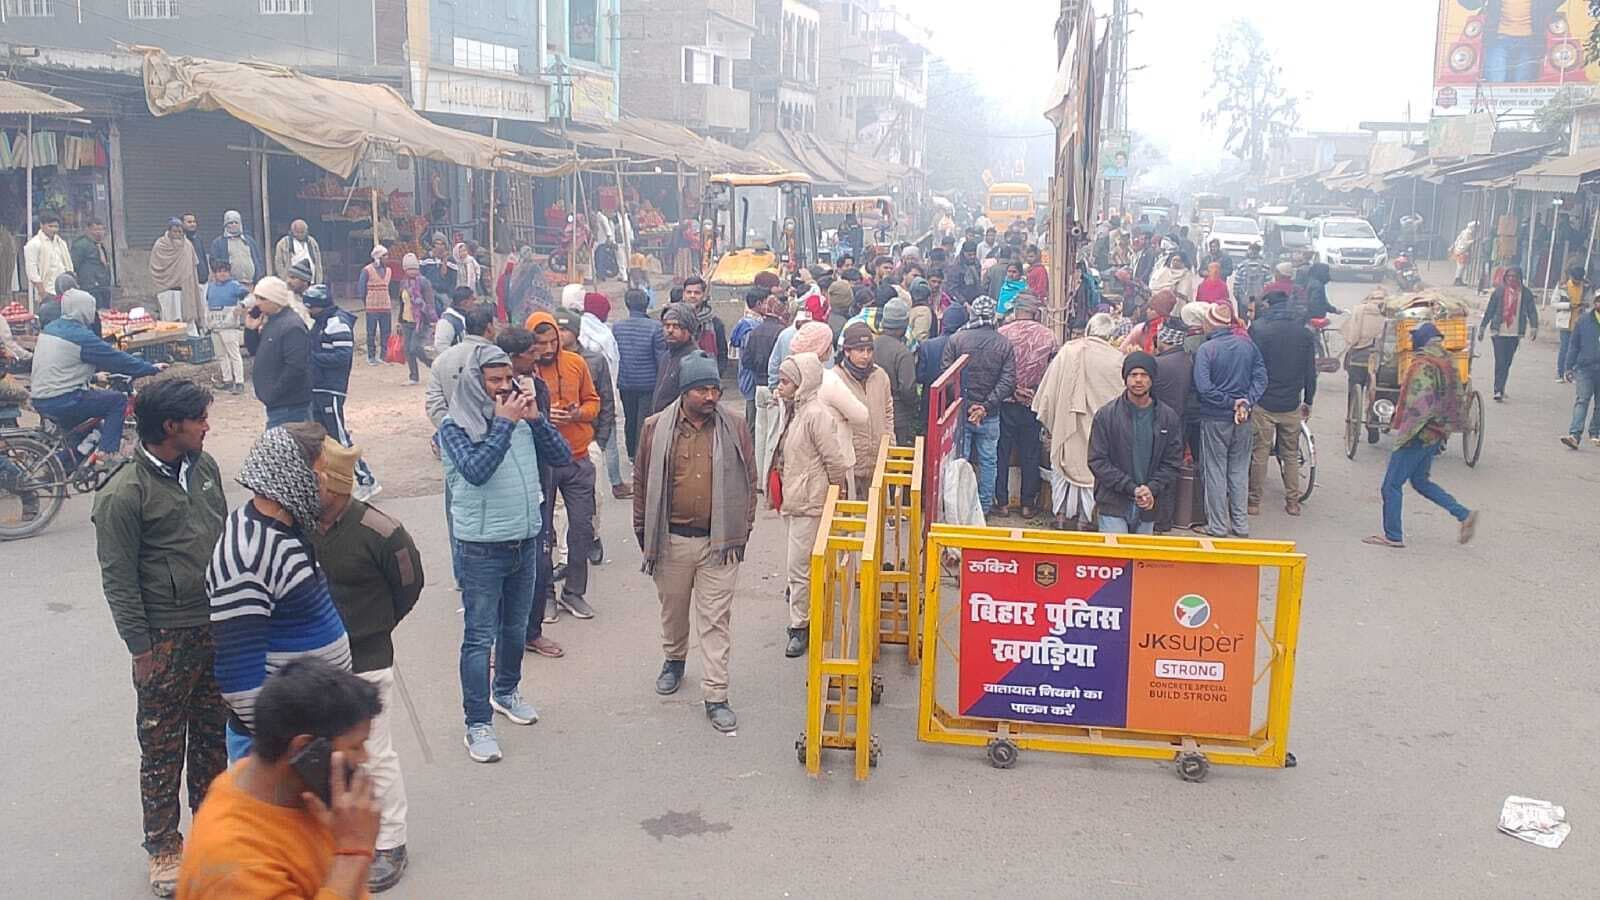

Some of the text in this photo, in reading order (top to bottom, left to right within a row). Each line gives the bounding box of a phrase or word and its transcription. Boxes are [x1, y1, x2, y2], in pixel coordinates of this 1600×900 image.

[968, 558, 1019, 575] रूकिये
[1075, 564, 1124, 580] STOP
[968, 592, 1123, 636] बिहार पुलिस
[990, 636, 1098, 671] खगड़िया
[1162, 663, 1218, 677] STRONG
[983, 683, 1037, 697] यातायात
[1083, 689, 1104, 700] का
[1149, 681, 1228, 692] CONCRETE SPECIAL
[1149, 690, 1228, 703] BUILD STRONG
[1011, 702, 1076, 717] पालन करें
